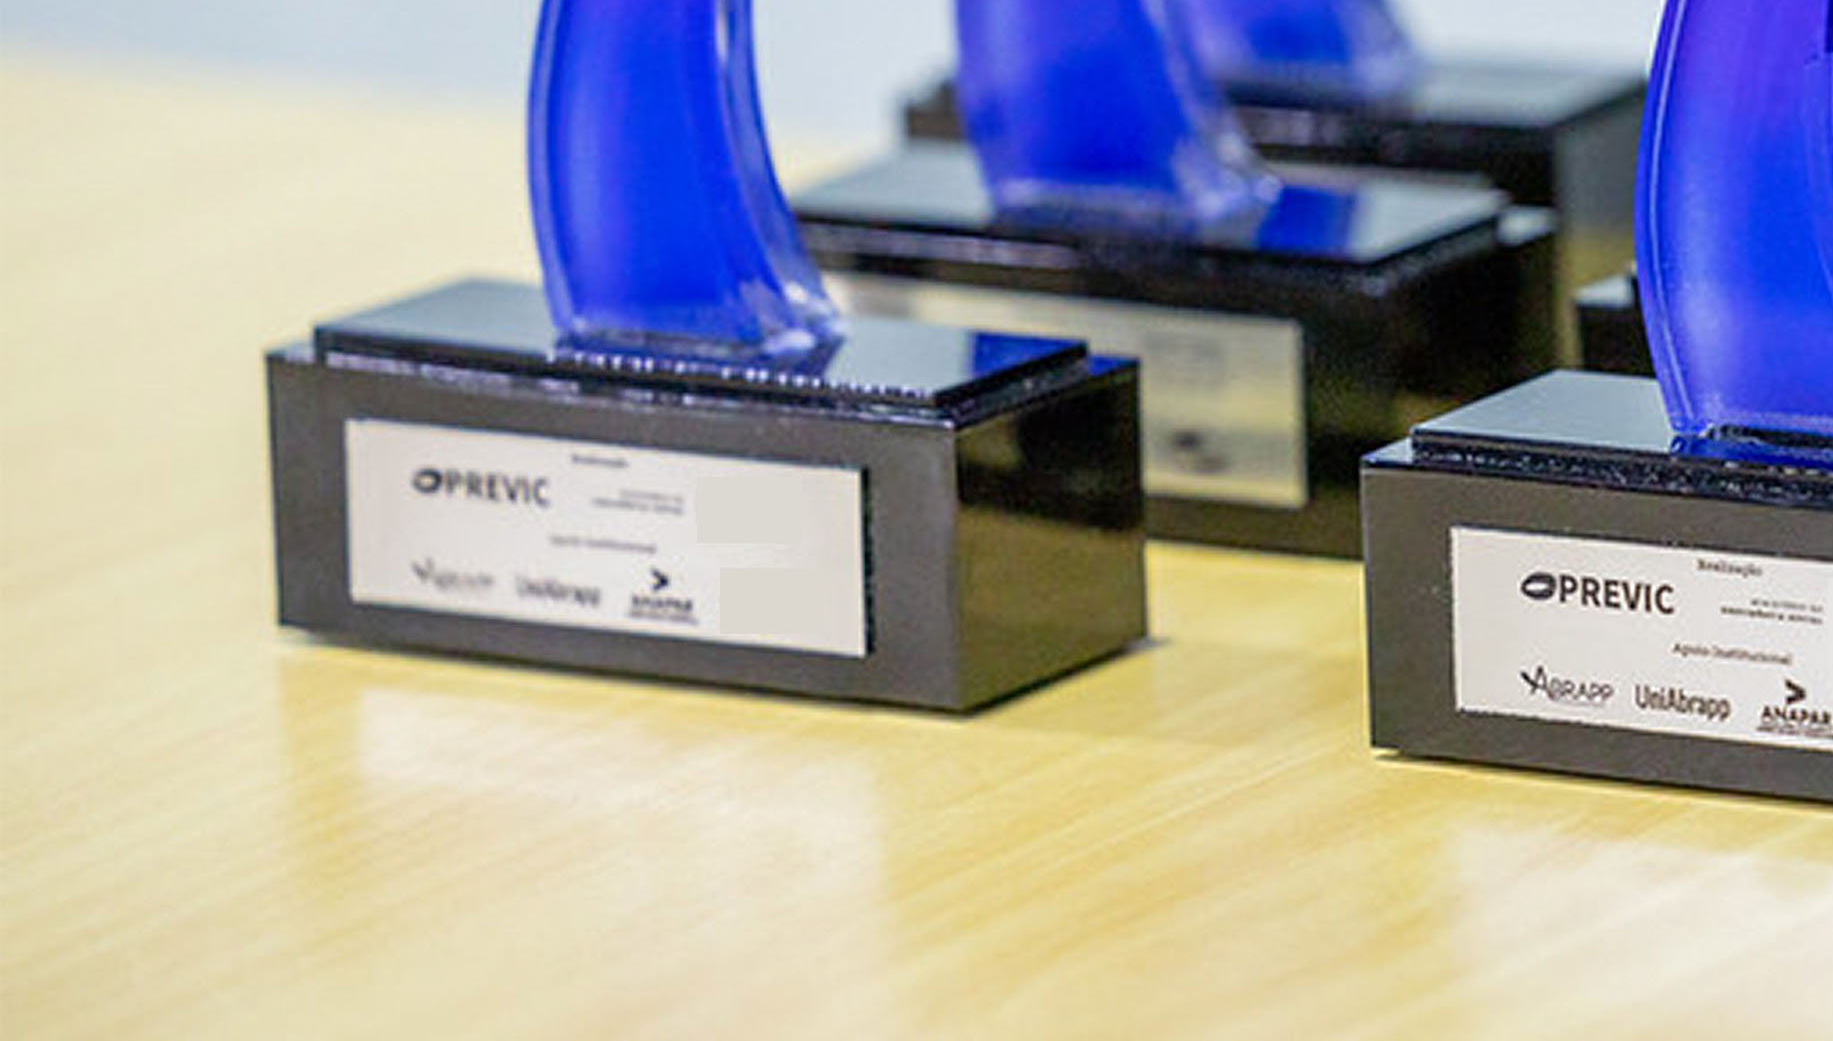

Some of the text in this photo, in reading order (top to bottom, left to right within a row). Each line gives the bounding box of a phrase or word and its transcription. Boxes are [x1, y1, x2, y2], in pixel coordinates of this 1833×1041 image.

[443, 469, 551, 509] PREVIC
[1558, 574, 1676, 615] PREVIC
[1634, 683, 1732, 722] UniAbrapp
[1760, 705, 1833, 725] ANAPAR
